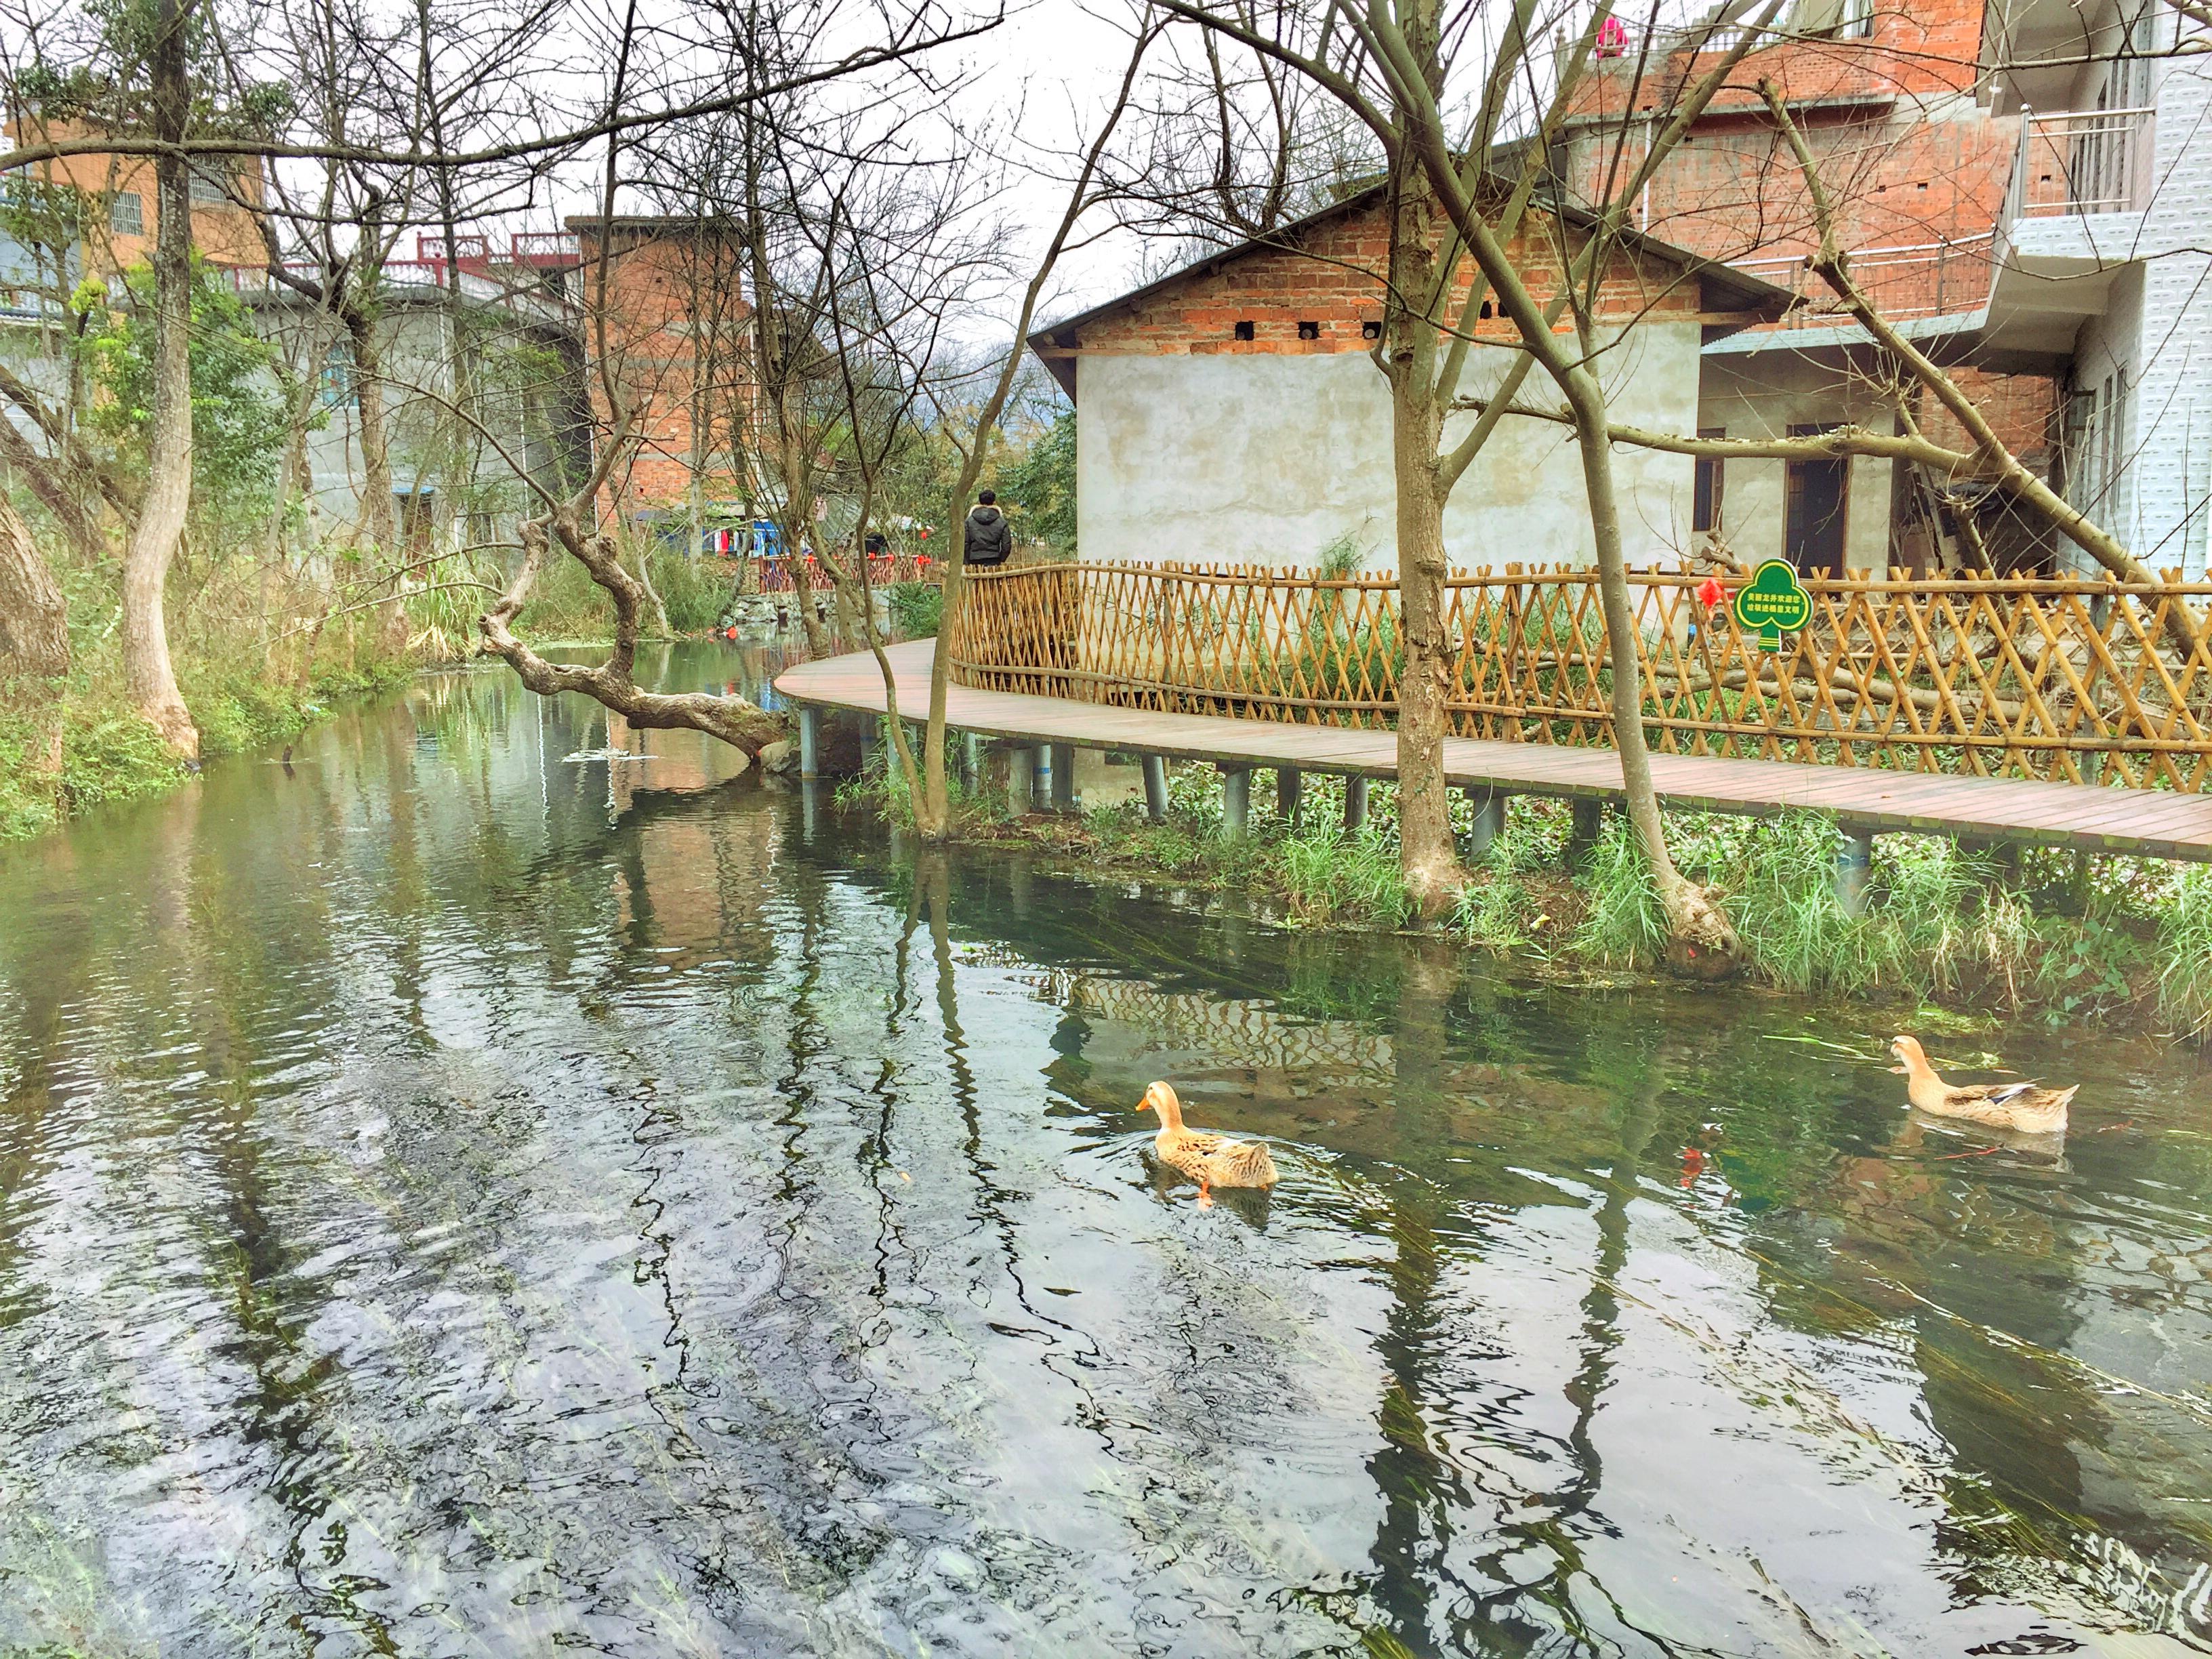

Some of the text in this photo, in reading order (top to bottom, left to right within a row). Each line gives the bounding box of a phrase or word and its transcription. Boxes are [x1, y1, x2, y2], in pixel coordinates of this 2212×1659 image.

[1747, 593, 1800, 603] 美丽龙井欢迎您
